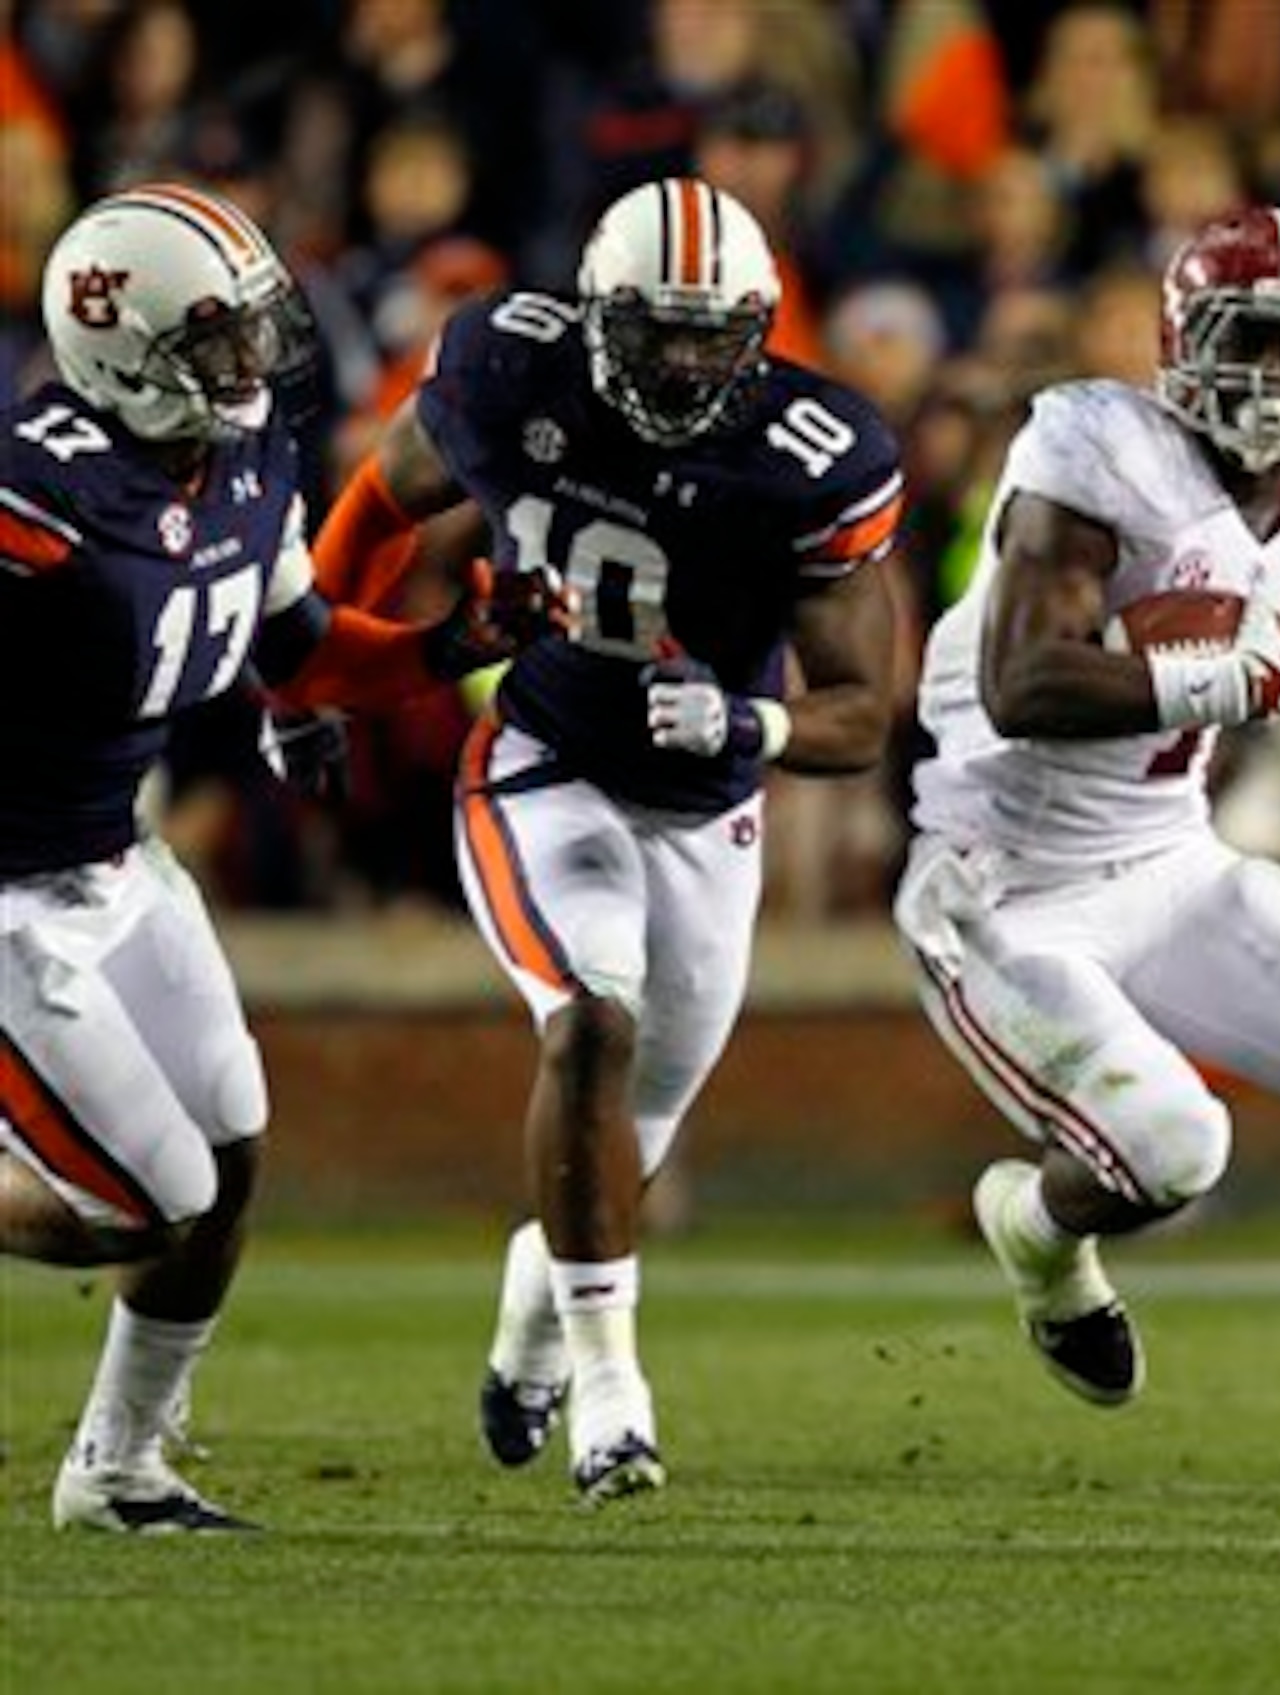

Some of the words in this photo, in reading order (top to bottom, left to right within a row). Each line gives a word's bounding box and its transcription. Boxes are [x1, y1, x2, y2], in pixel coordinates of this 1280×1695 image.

[14, 405, 112, 463] 17
[766, 397, 855, 478] 10
[135, 561, 262, 718] 17
